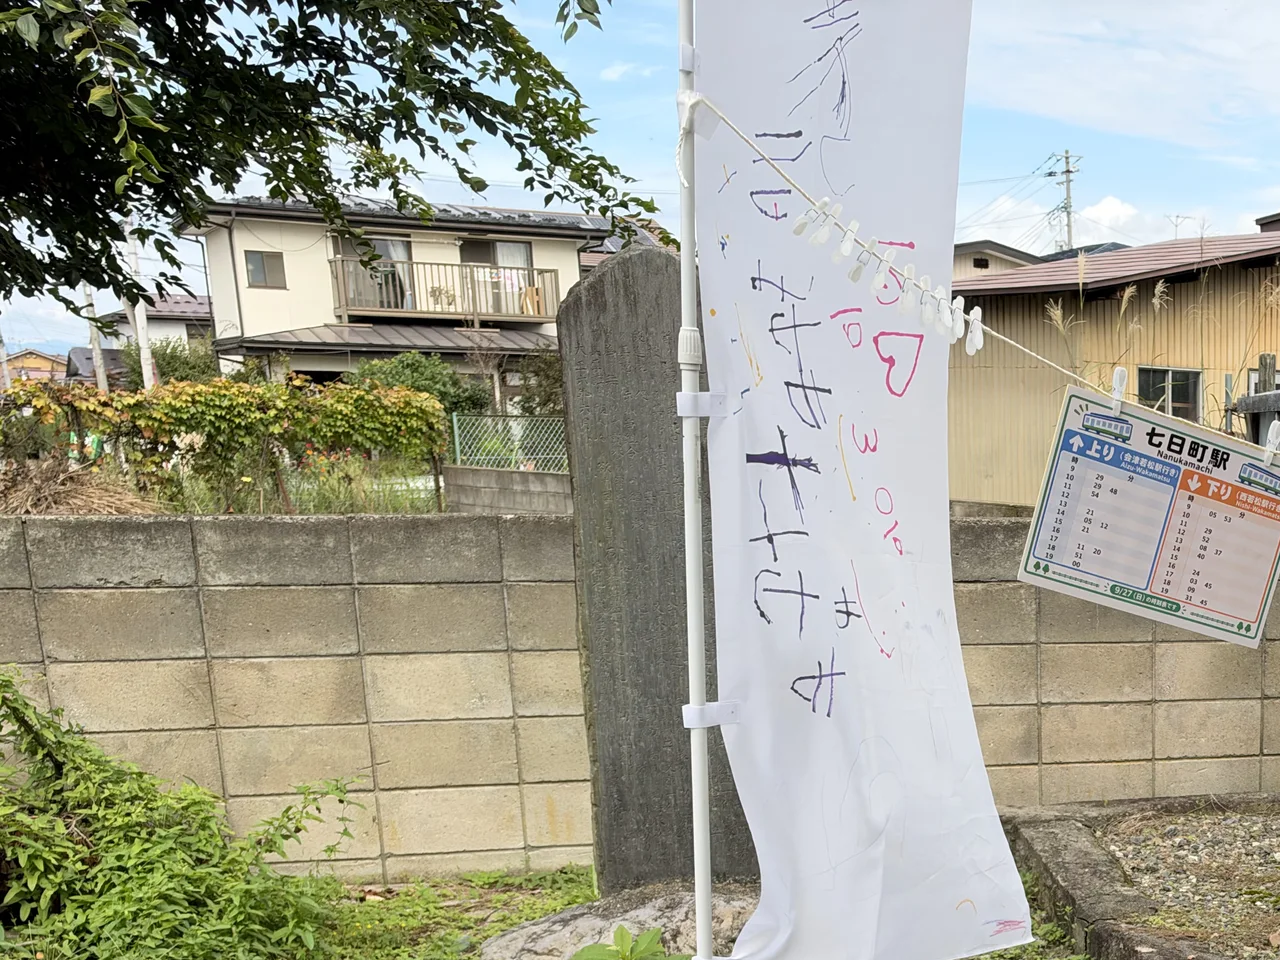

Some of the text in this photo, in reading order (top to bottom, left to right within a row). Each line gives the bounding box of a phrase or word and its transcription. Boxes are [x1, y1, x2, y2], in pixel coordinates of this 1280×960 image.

[1086, 440, 1115, 461] 上り
[1145, 427, 1230, 472] 七日町駅
[1157, 450, 1214, 475] Nanukamachi
[1120, 461, 1170, 483] Aizu-Wakamatsu
[1095, 473, 1104, 482] 29
[1065, 473, 1118, 495] 10 29 48
[1206, 480, 1232, 500] 下り
[1061, 491, 1070, 499] 12
[1091, 491, 1099, 499] 54
[1086, 508, 1094, 516] 21
[1182, 511, 1191, 519] 10
[1056, 508, 1109, 530] 14 05 12
[1209, 511, 1217, 519] 05
[1223, 515, 1232, 523] 53
[1052, 526, 1060, 534] 16
[1177, 528, 1186, 536] 12
[1204, 527, 1213, 535] 29
[1047, 543, 1056, 551] 18
[1172, 545, 1181, 553] 14
[1199, 544, 1208, 552] 08
[1214, 548, 1223, 556] 37
[1045, 552, 1081, 568] 19 00
[1170, 553, 1178, 561] 15
[1192, 569, 1200, 577] 24
[1163, 578, 1171, 586] 18
[1204, 582, 1213, 590] 45
[1160, 587, 1169, 595] 19
[1199, 599, 1208, 607] 45
